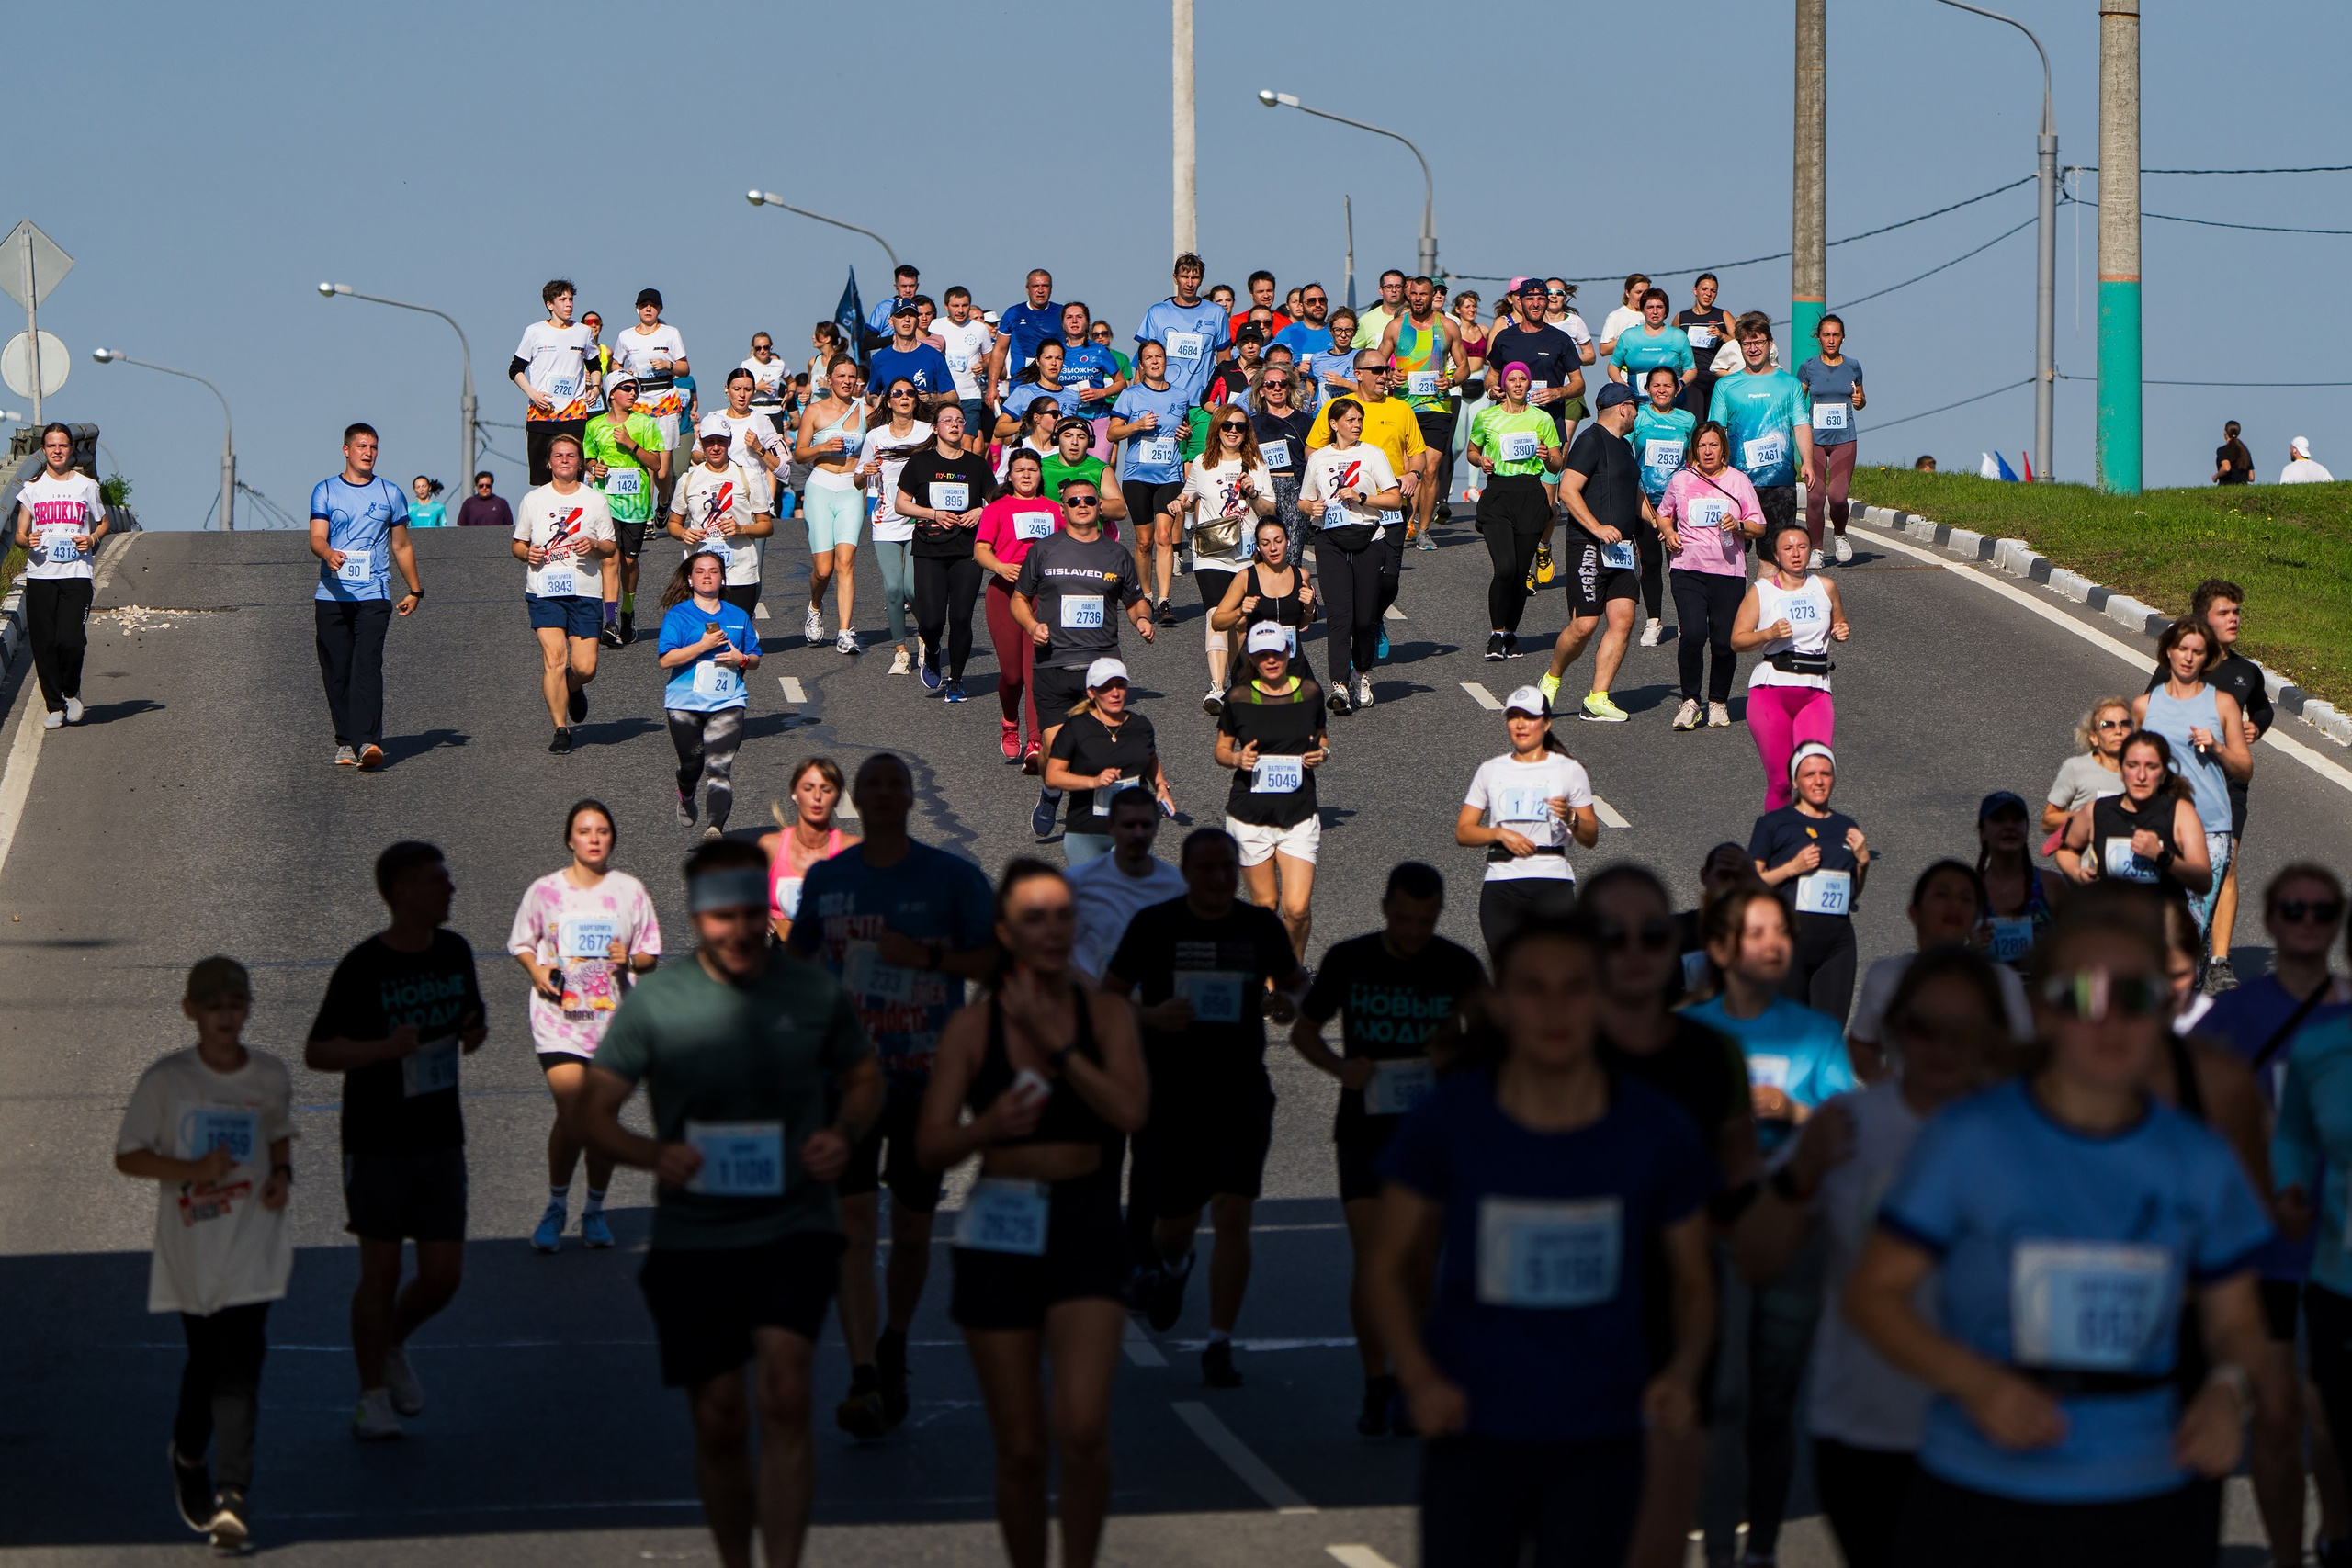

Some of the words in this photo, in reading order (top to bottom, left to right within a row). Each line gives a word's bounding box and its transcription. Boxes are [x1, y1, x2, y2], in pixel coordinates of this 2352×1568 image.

[1177, 344, 1198, 356] 4684
[553, 385, 572, 396] 2720
[1826, 416, 1841, 426] 630
[1151, 449, 1172, 460] 2512
[1513, 445, 1535, 457] 3807
[1758, 449, 1779, 463] 2461
[1268, 453, 1285, 466] 818
[1657, 453, 1680, 466] 2933
[617, 480, 638, 491] 1424
[944, 496, 963, 507] 895
[1327, 512, 1343, 525] 621
[1028, 524, 1052, 536] 2451
[53, 547, 77, 558] 4313
[348, 565, 361, 577] 90
[1044, 568, 1103, 579] GISLAVED
[548, 581, 572, 592] 3843
[1076, 611, 1101, 625] 2736
[1789, 606, 1815, 620] 1273
[714, 679, 728, 692] 24
[1267, 773, 1297, 788] 5049
[1514, 800, 1544, 816] 172
[1821, 892, 1844, 908] 227
[380, 974, 467, 1012] НОВЫЕ
[1348, 993, 1455, 1021] НОВЫЕ
